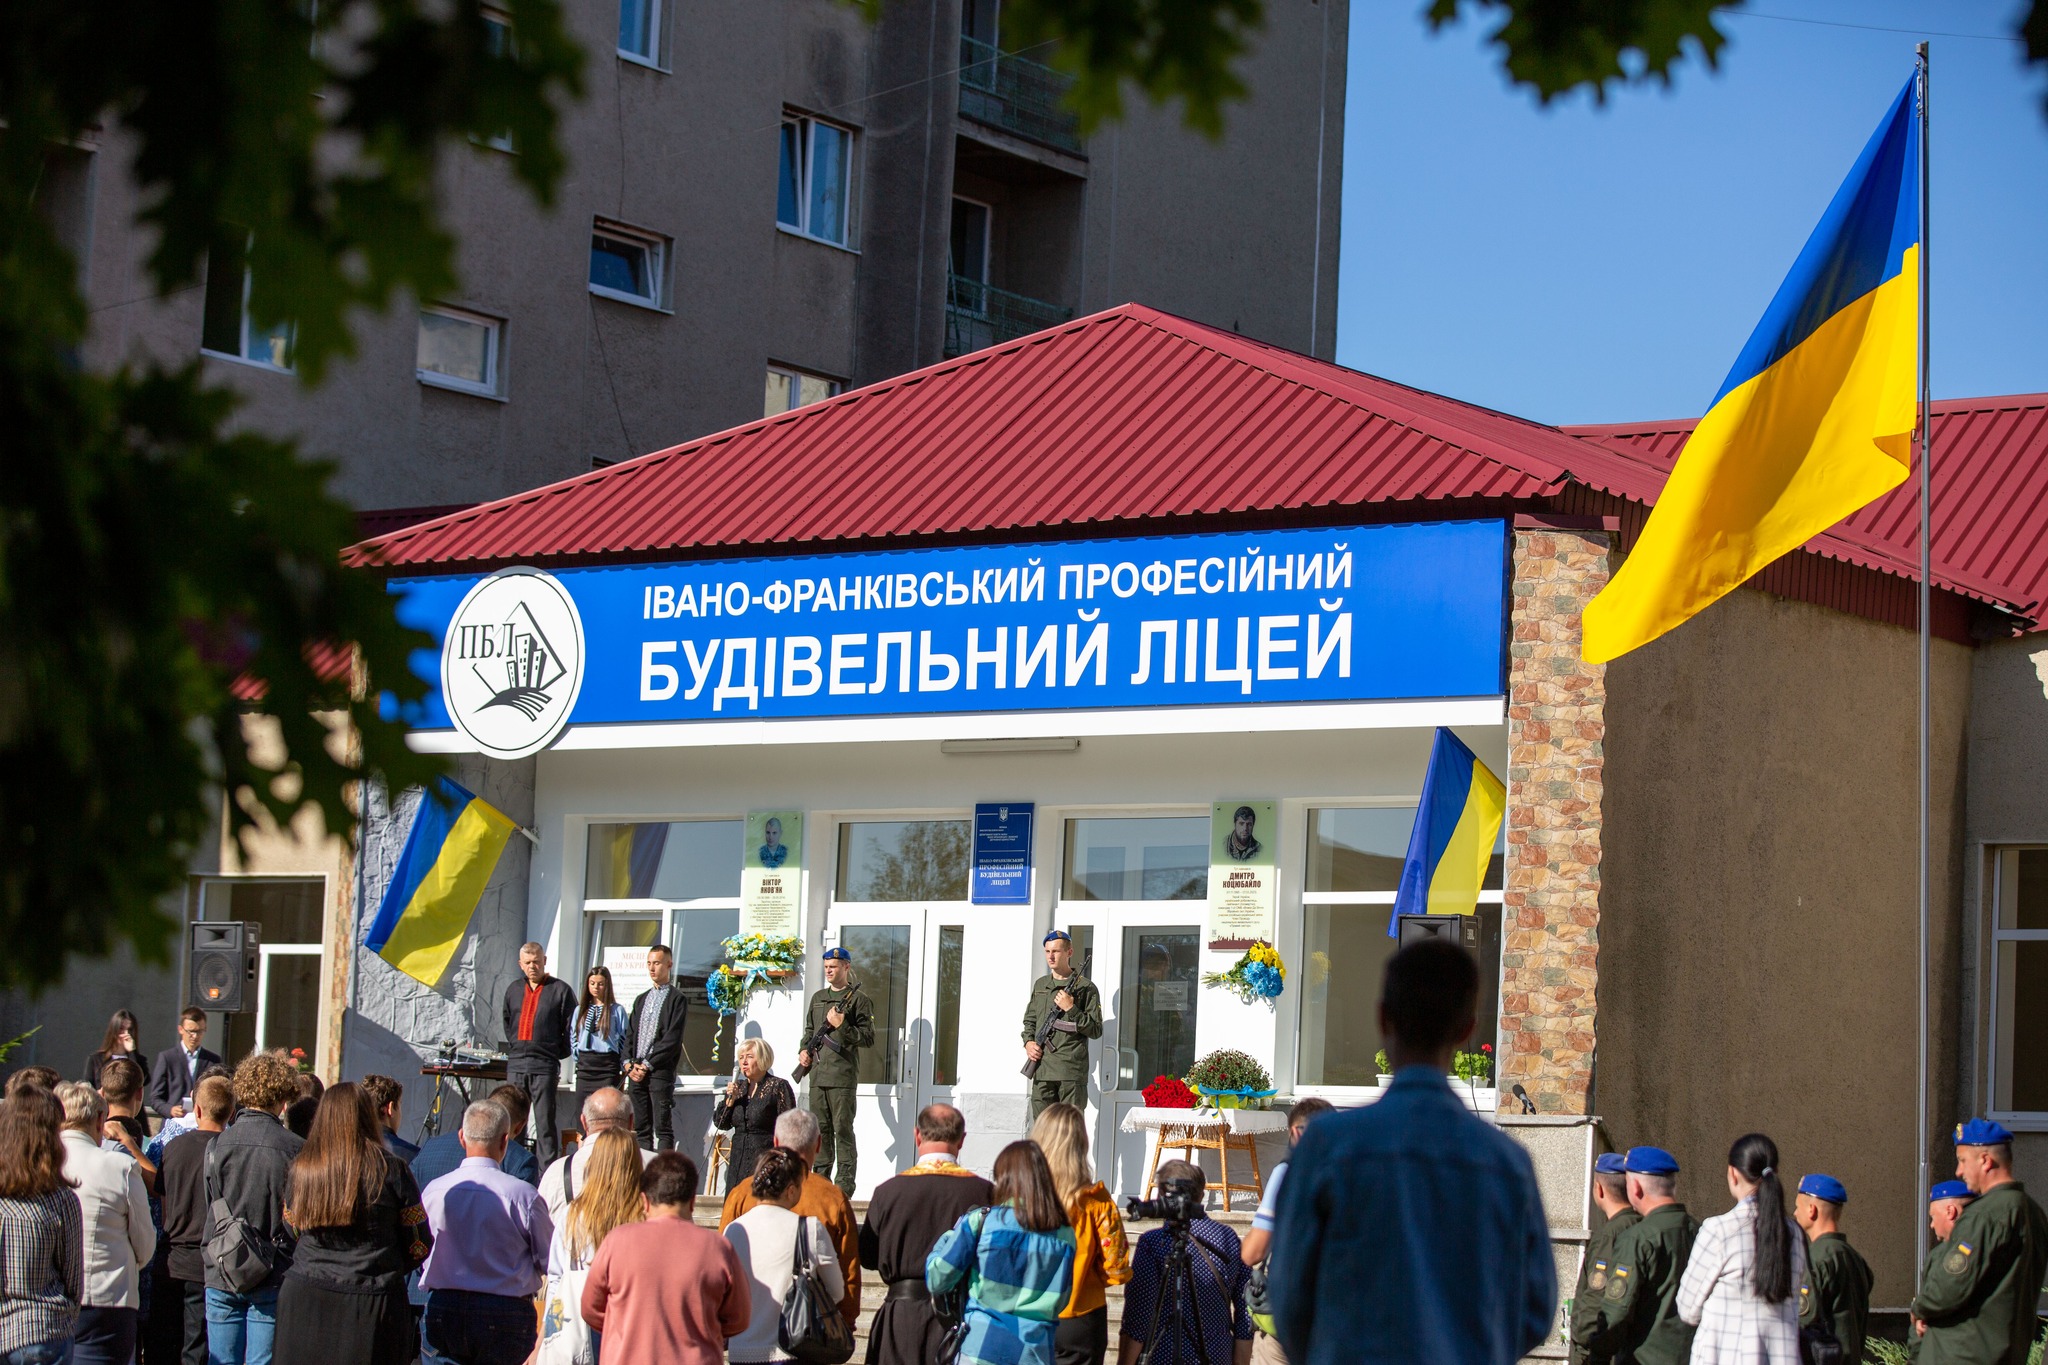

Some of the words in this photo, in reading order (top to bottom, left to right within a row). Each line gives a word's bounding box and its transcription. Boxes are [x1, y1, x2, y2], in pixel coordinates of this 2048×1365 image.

[643, 557, 1045, 619] ІВАНО-ФРАНКІВСЬКИЙ
[1058, 542, 1353, 600] ПРОФЕСІЙНИЙ
[458, 622, 517, 659] ПБЛ
[639, 607, 1110, 711] БУДІВЕЛЬНИЙ
[1131, 597, 1353, 694] ЛІЦЕЙ
[762, 878, 782, 886] ВІКТОР
[1222, 880, 1261, 889] КОЦЮБАЙЛО
[1229, 872, 1255, 880] ДМИТРО
